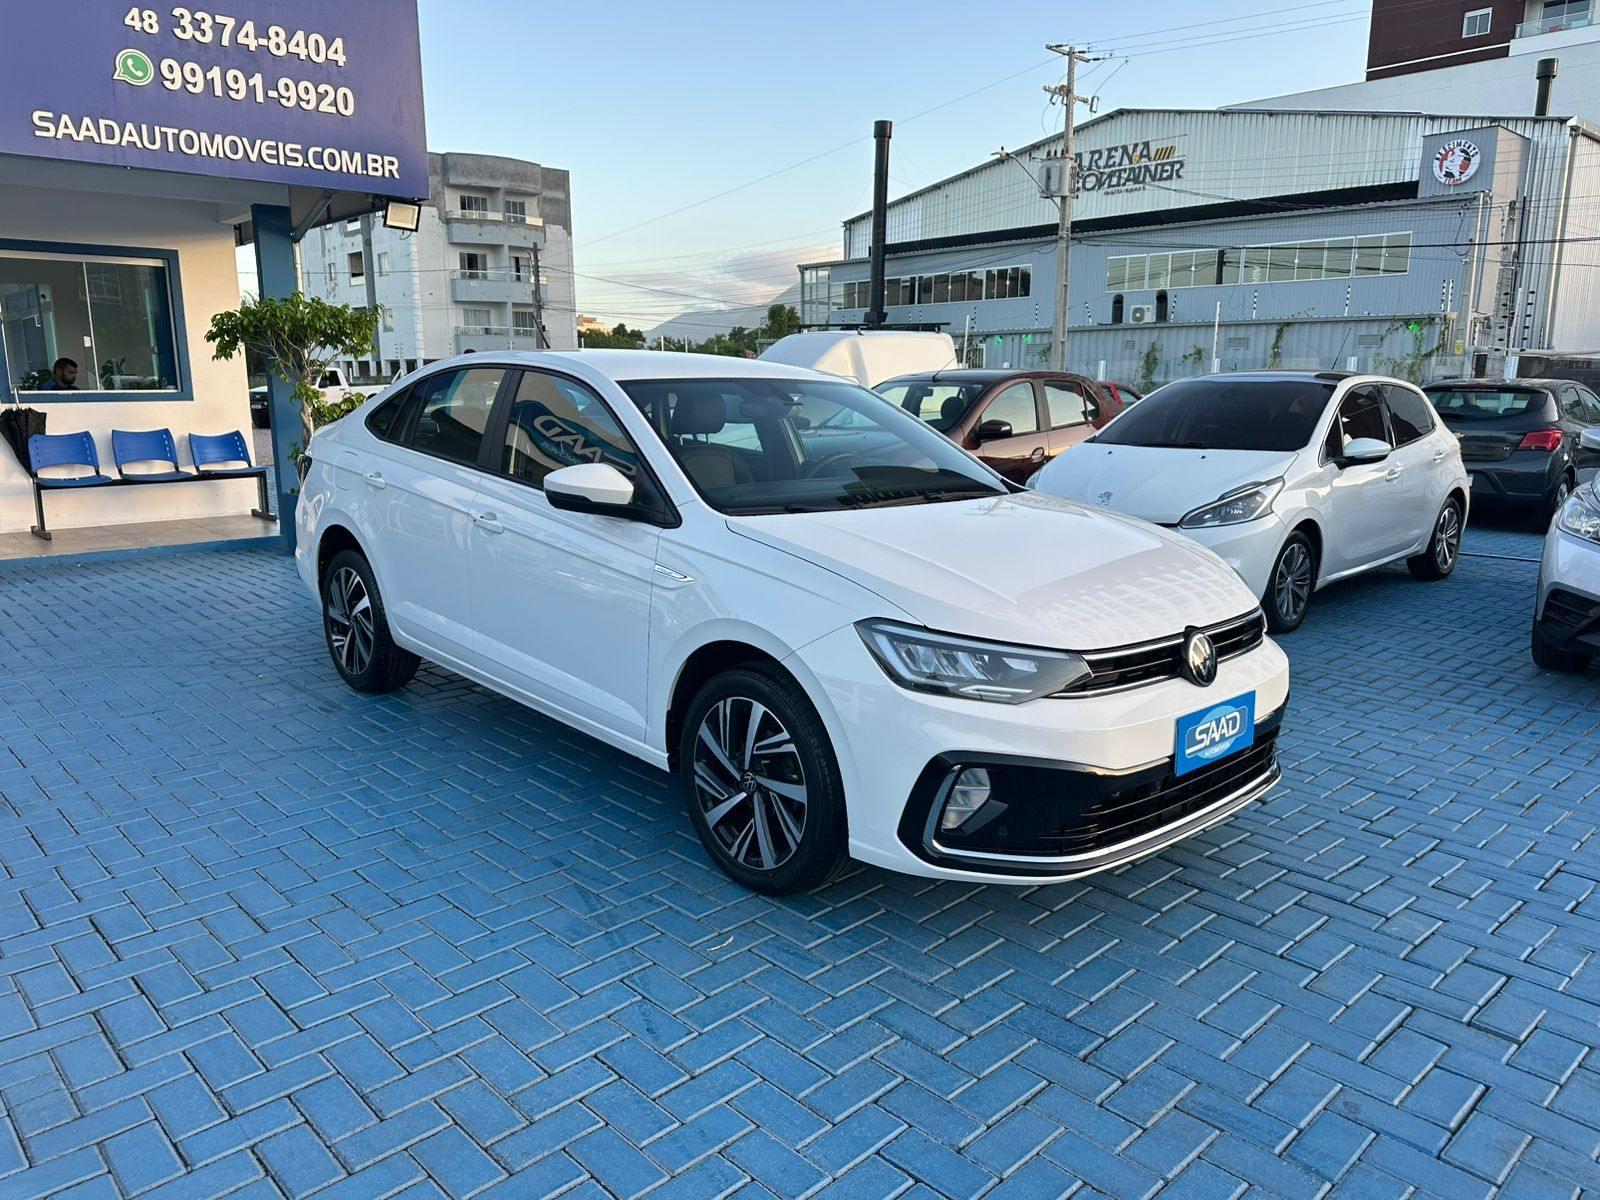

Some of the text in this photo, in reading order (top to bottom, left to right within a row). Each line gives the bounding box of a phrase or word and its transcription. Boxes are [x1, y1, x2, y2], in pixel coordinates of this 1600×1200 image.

[125, 7, 346, 67] 48 3374-8404
[160, 58, 355, 117] 99191-9920
[31, 110, 400, 179] SAADAUTOMOVEIS.COM.BR
[1186, 711, 1240, 756] SAAD
